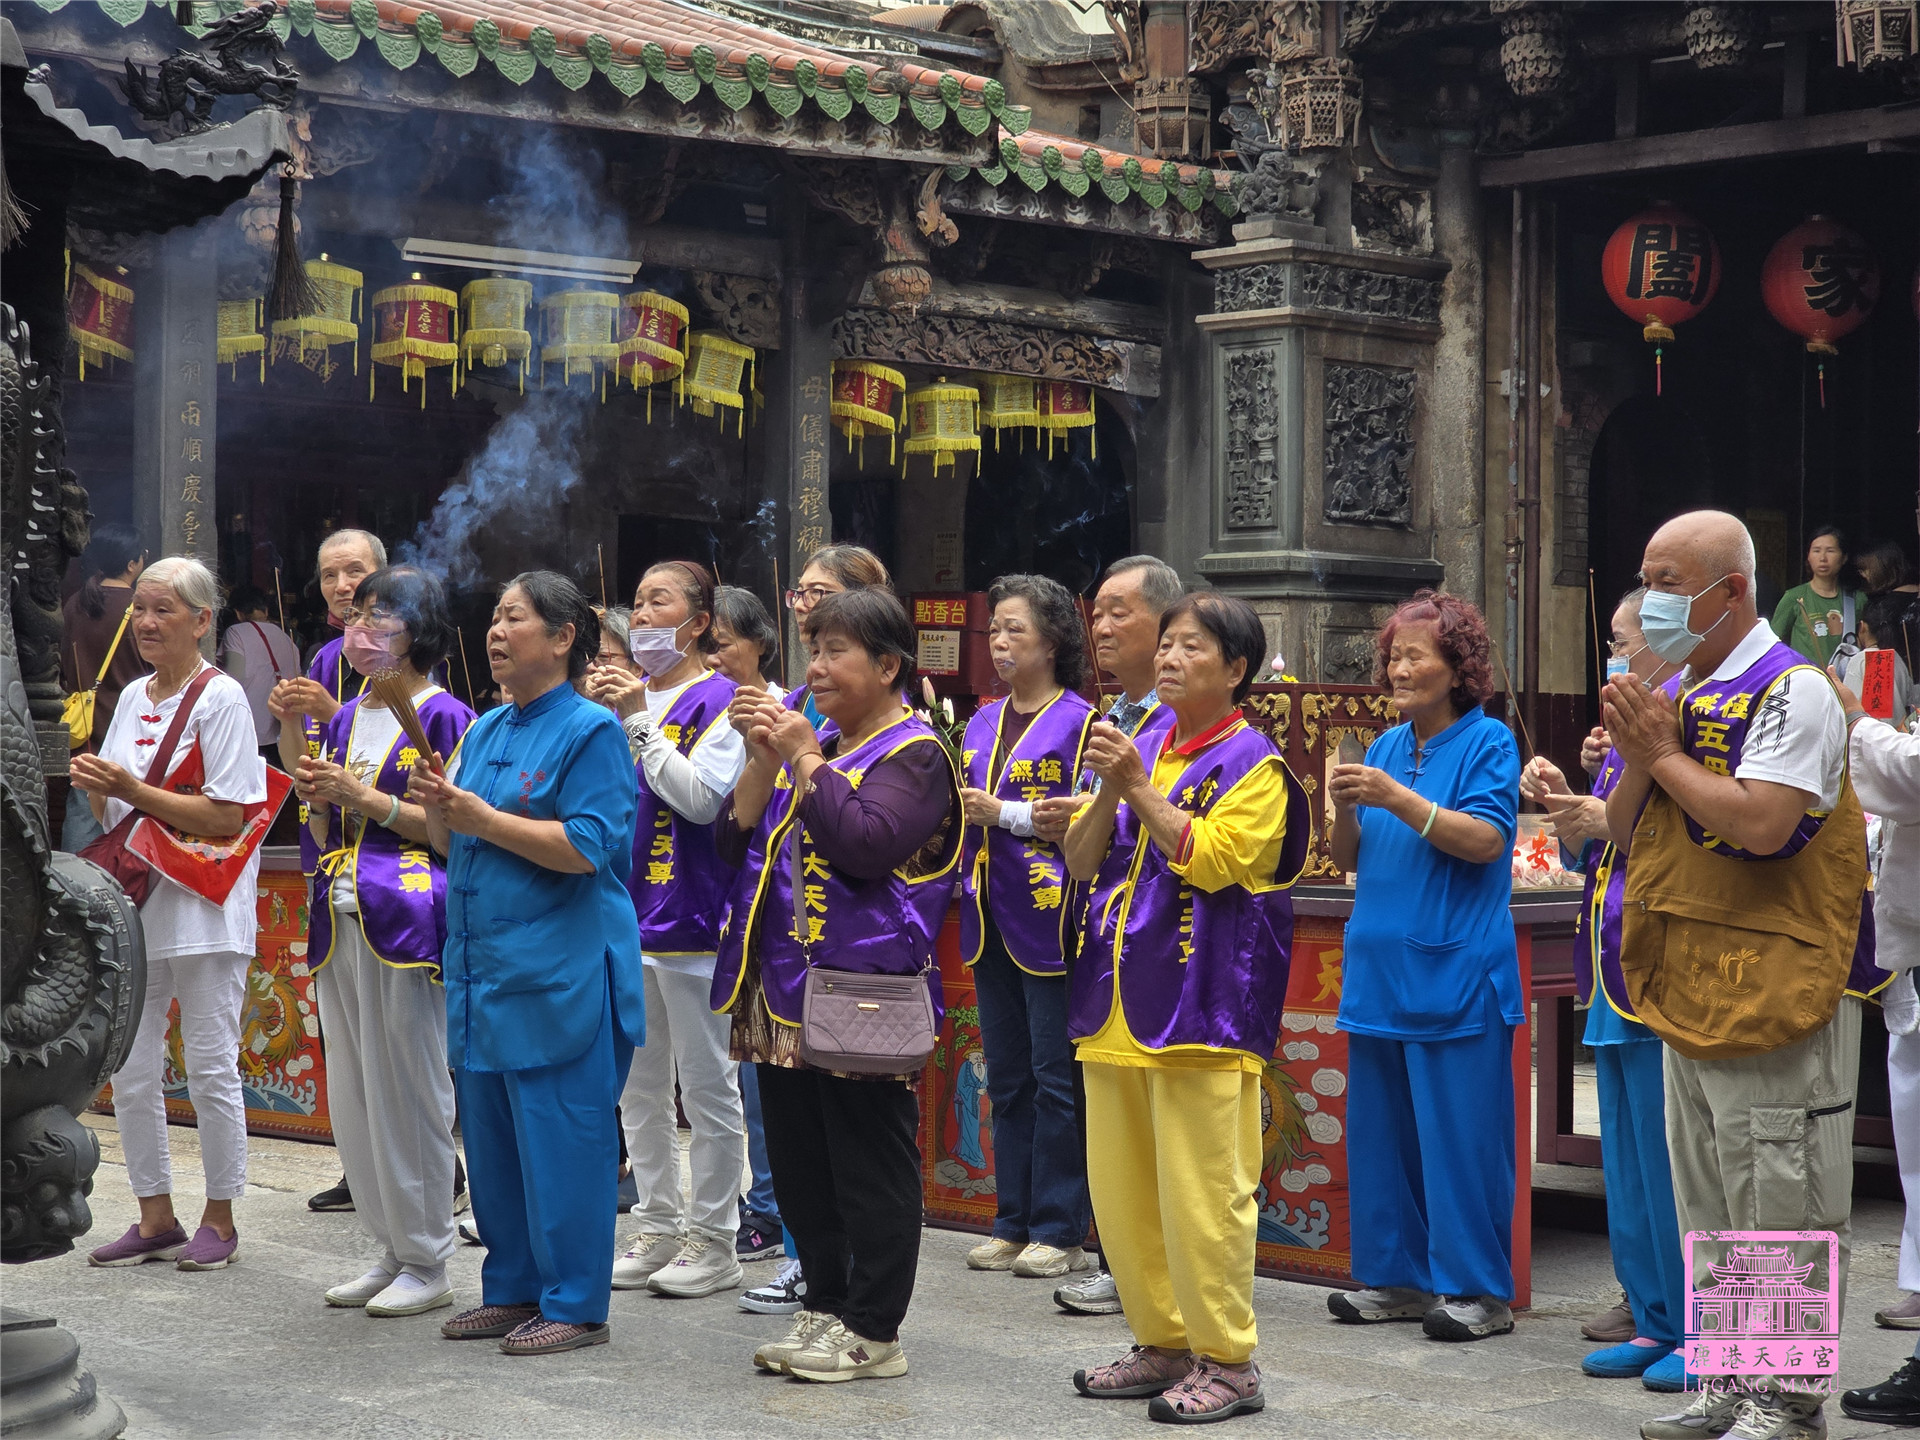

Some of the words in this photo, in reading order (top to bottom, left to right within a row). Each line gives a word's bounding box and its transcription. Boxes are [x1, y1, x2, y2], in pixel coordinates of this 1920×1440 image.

[1801, 244, 1868, 318] 家
[417, 301, 432, 334] 天后宮
[915, 601, 966, 624] 點香台
[1690, 692, 1753, 719] 無極
[1009, 759, 1062, 784] 無極
[847, 1346, 870, 1365] N
